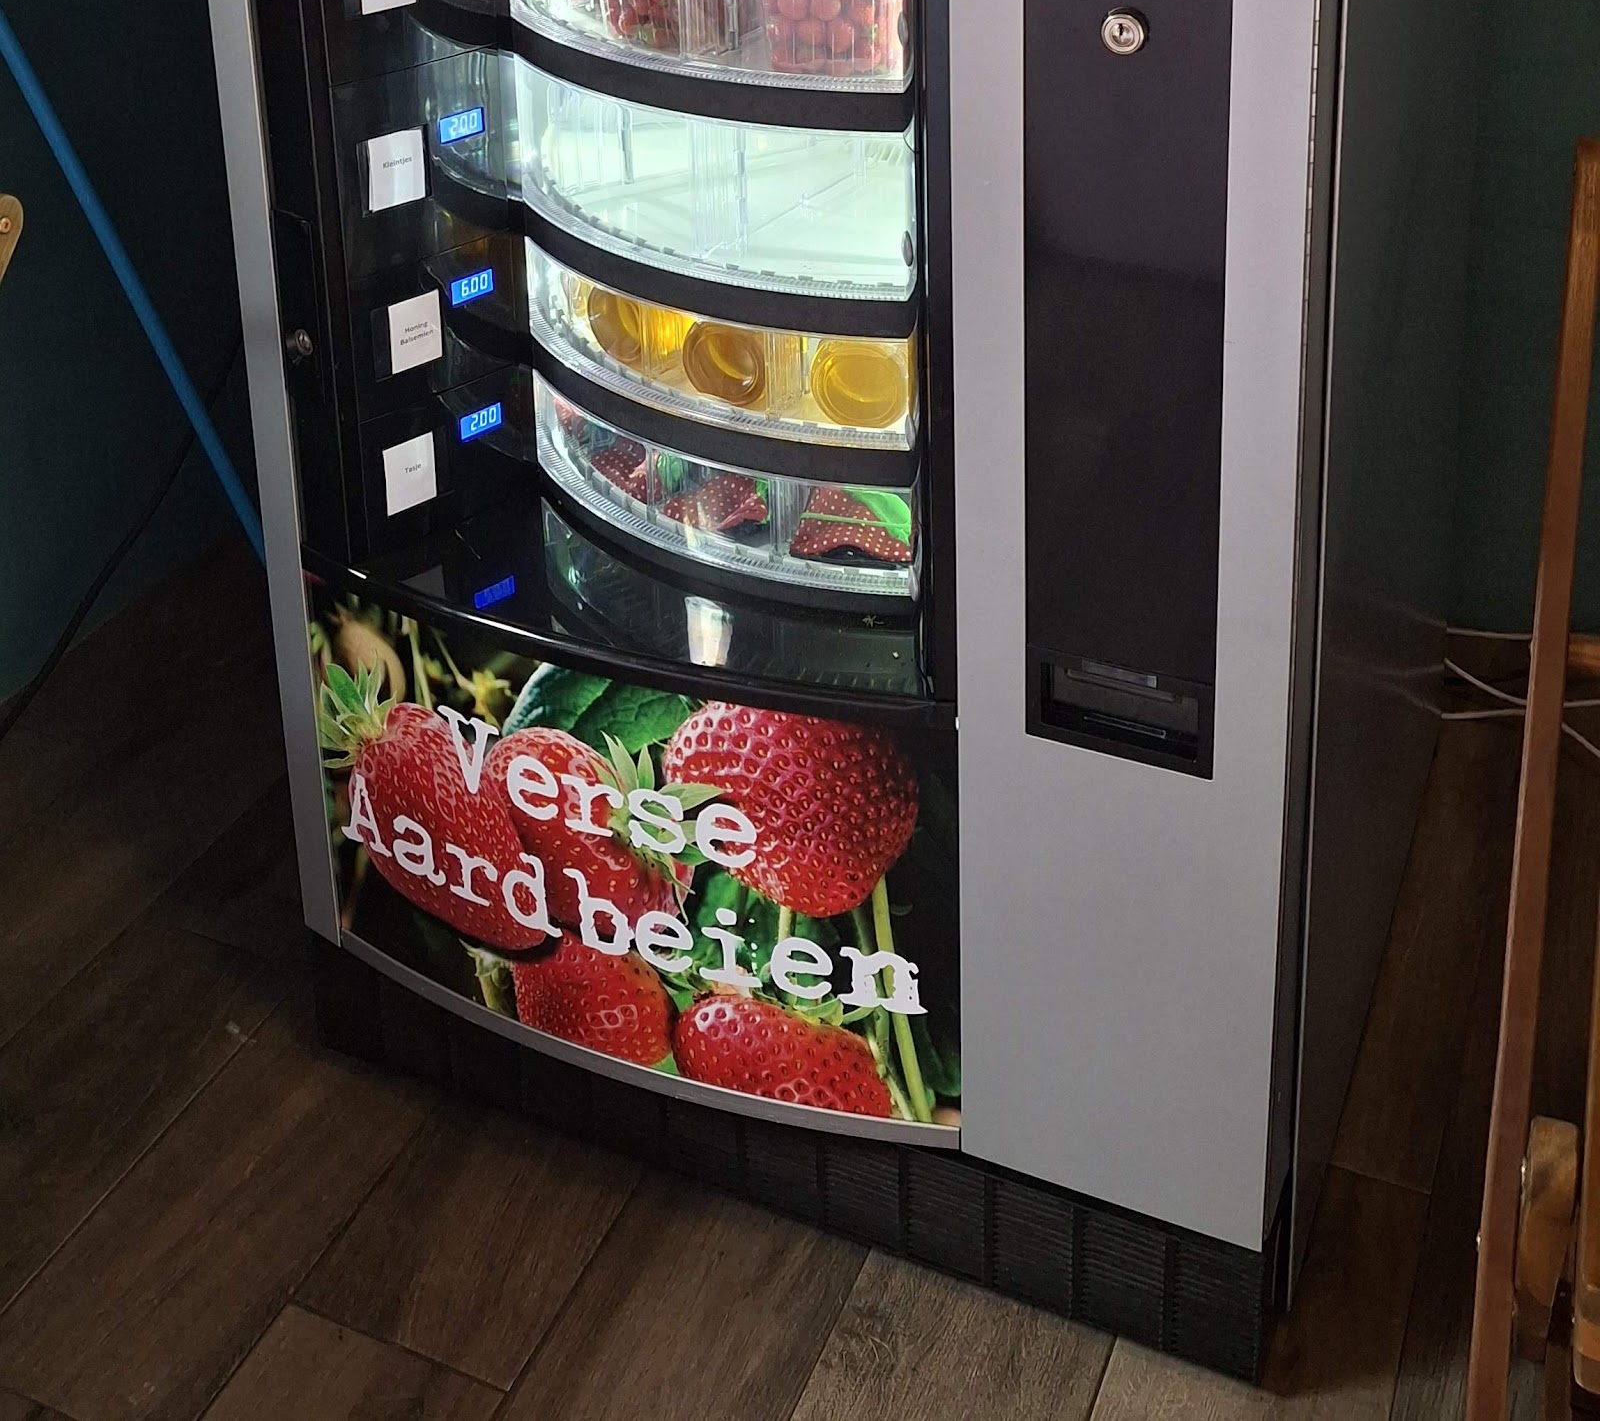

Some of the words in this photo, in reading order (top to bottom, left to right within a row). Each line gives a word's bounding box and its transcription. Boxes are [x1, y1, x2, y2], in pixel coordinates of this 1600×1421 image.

[382, 156, 412, 169] Kleintjes
[461, 273, 488, 297] 6.00
[404, 320, 428, 334] Honing
[470, 407, 497, 431] 2.00
[405, 463, 421, 474] Tasje
[436, 705, 758, 868] Verse
[341, 775, 928, 1016] Aardbeien
